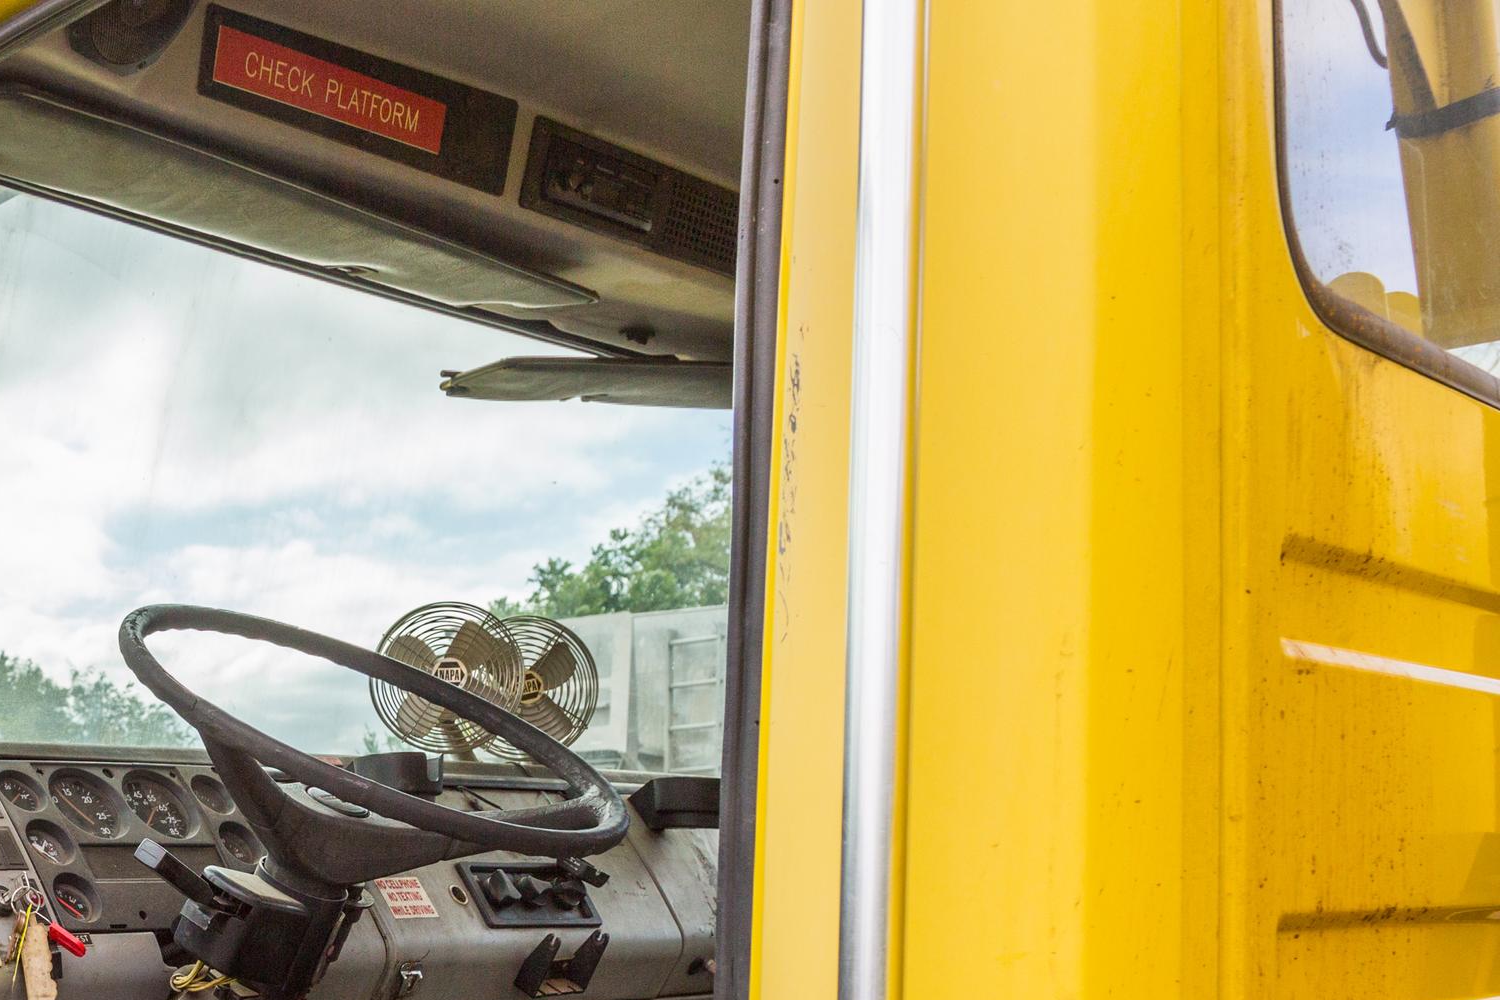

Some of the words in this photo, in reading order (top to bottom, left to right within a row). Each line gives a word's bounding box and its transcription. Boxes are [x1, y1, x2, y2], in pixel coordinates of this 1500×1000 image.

[244, 50, 314, 99] CHECK
[325, 78, 420, 134] PLATFORM
[439, 669, 460, 681] NAPA
[62, 788, 72, 796] 15
[81, 795, 93, 804] 20
[146, 794, 157, 802] 55
[158, 804, 168, 812] 65
[96, 812, 107, 820] 25
[100, 827, 111, 835] 30
[376, 879, 387, 889] NO
[387, 892, 398, 902] NO
[395, 891, 423, 901] TEXTING
[390, 905, 412, 916] WHILE
[408, 904, 435, 915] DRIVING
